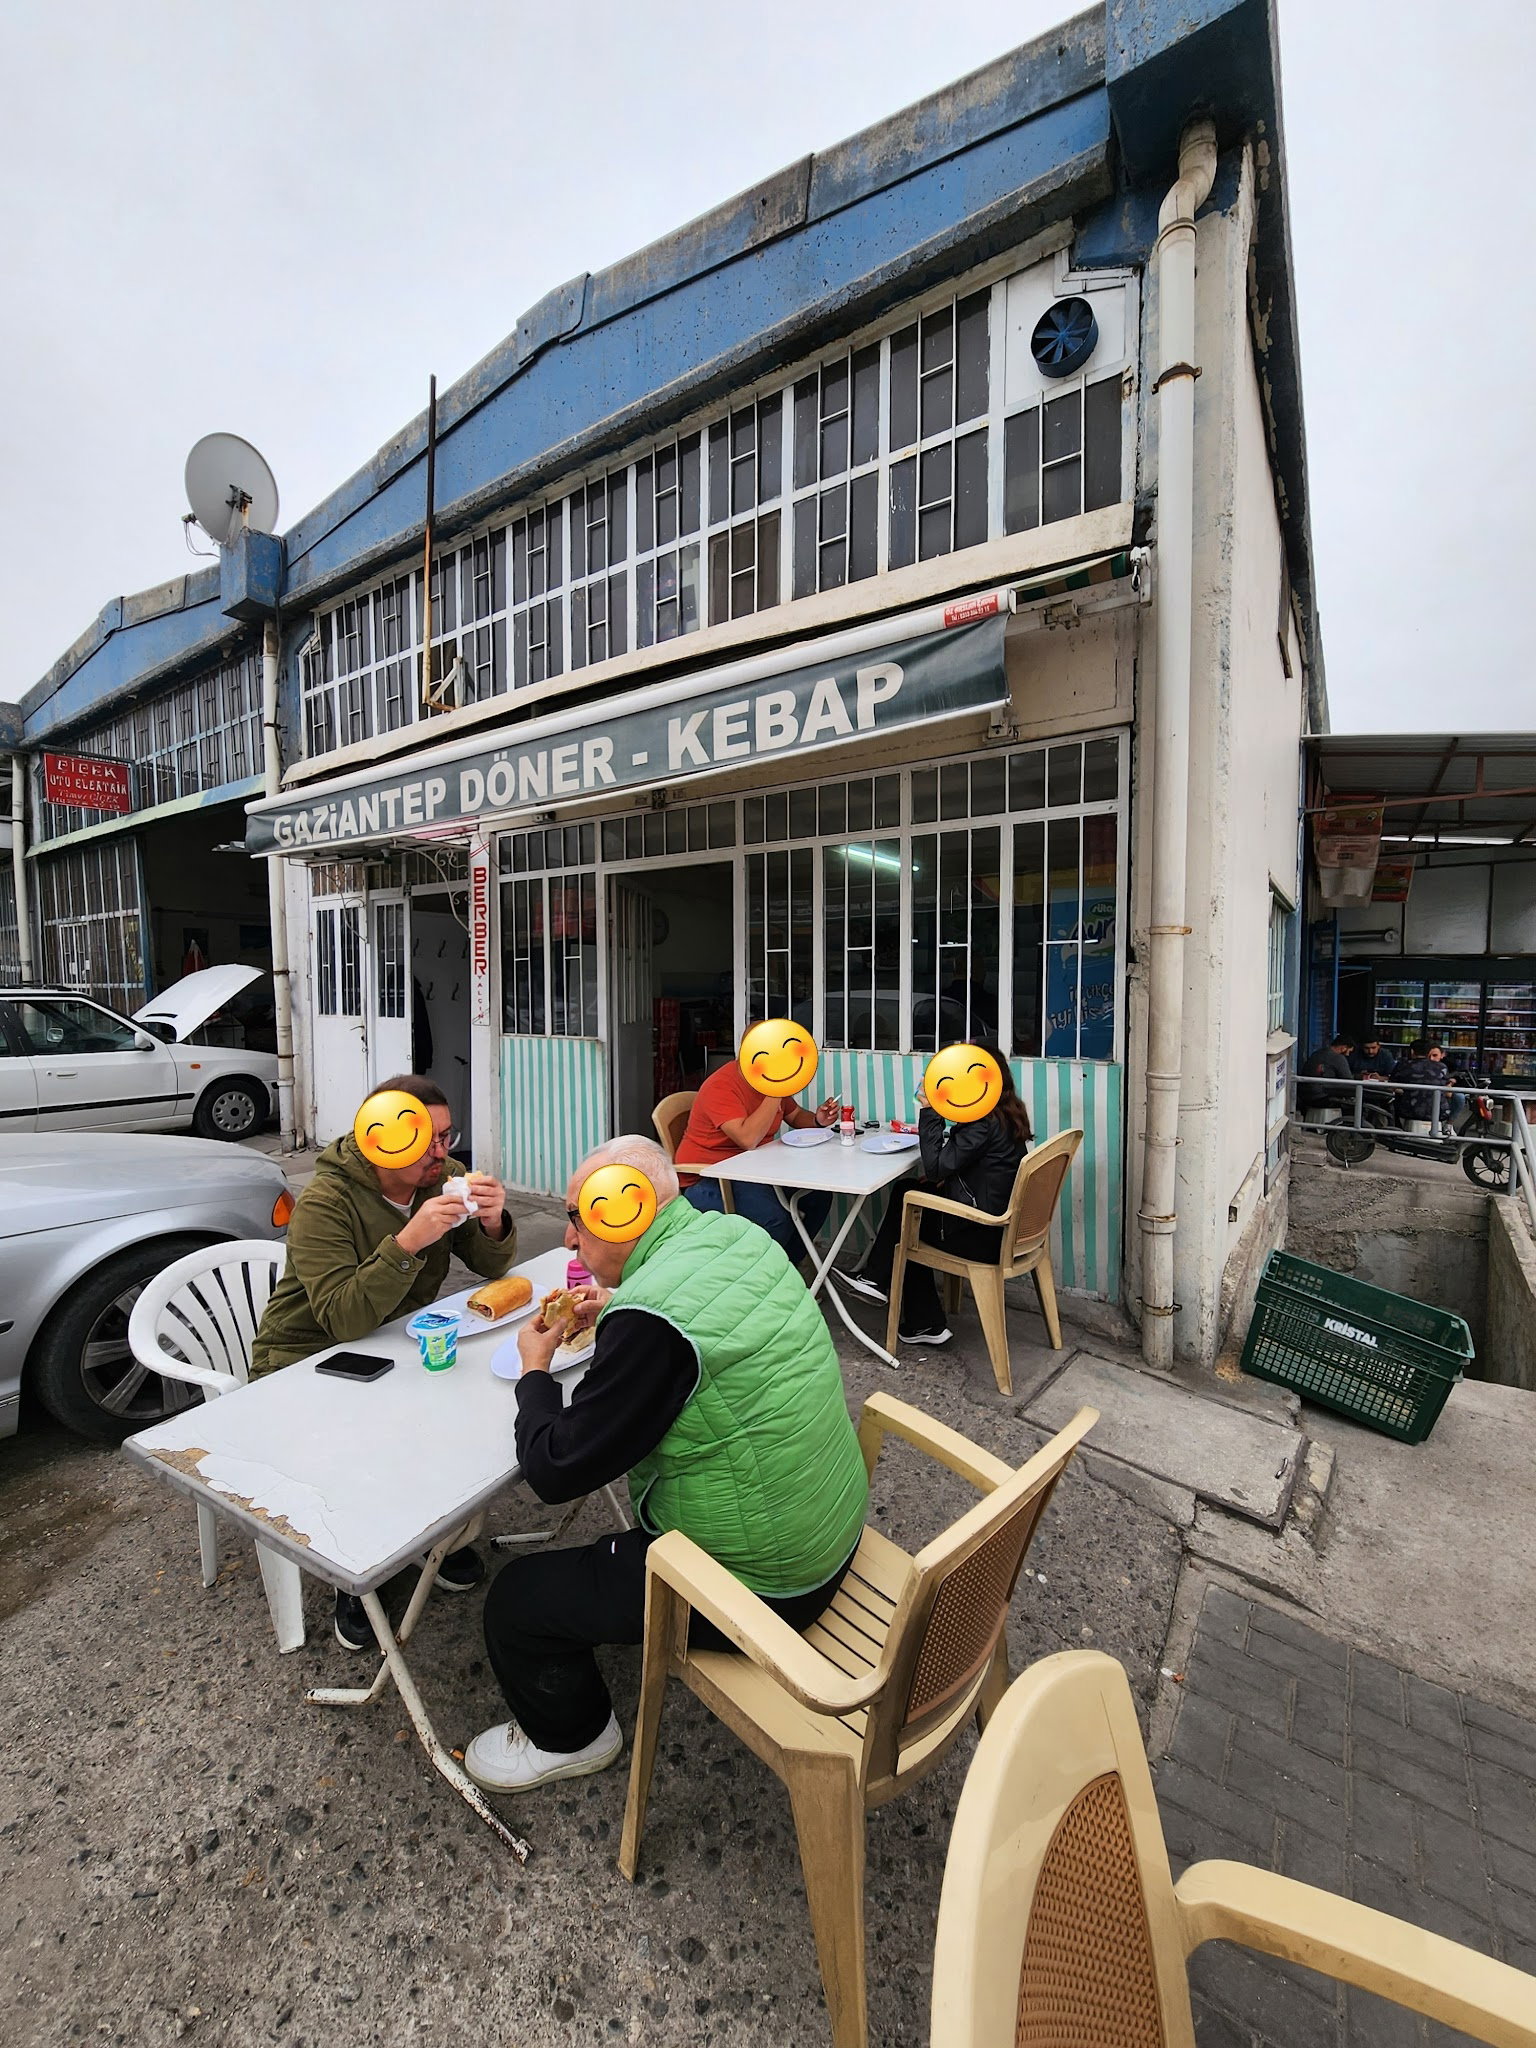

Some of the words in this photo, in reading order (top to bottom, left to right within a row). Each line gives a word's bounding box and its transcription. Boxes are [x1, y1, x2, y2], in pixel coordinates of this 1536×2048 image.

[460, 736, 617, 814] DÖNER
[667, 661, 905, 771] KEBAP
[473, 867, 487, 975] BERBER
[1323, 1317, 1379, 1348] KRİSTAL
